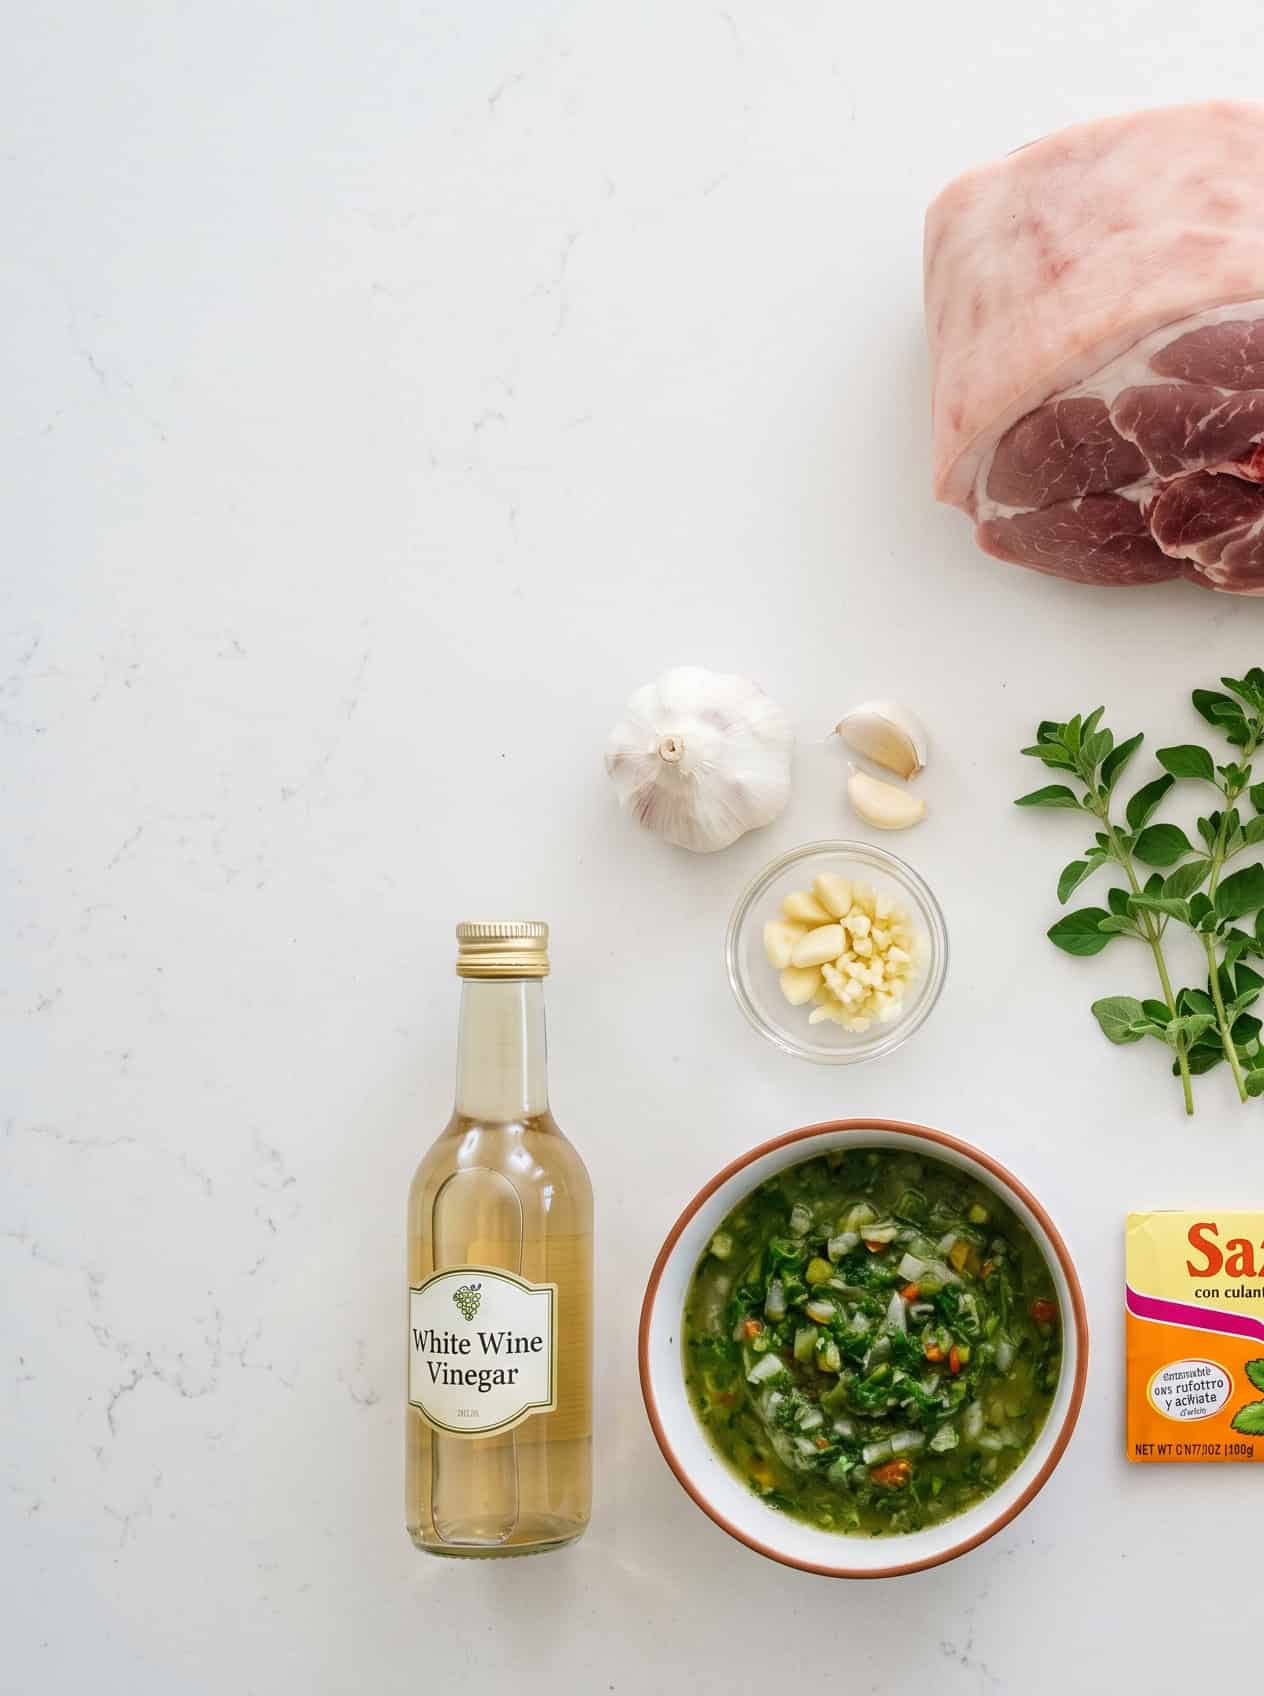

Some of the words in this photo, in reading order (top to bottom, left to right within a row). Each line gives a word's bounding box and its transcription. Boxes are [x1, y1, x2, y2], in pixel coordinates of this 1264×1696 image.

[1194, 1287, 1219, 1299] con
[413, 1328, 471, 1355] White
[477, 1331, 543, 1355] Wine
[426, 1360, 519, 1393] Vinegar
[1135, 1444, 1154, 1456] NET
[1157, 1444, 1173, 1456] WT
